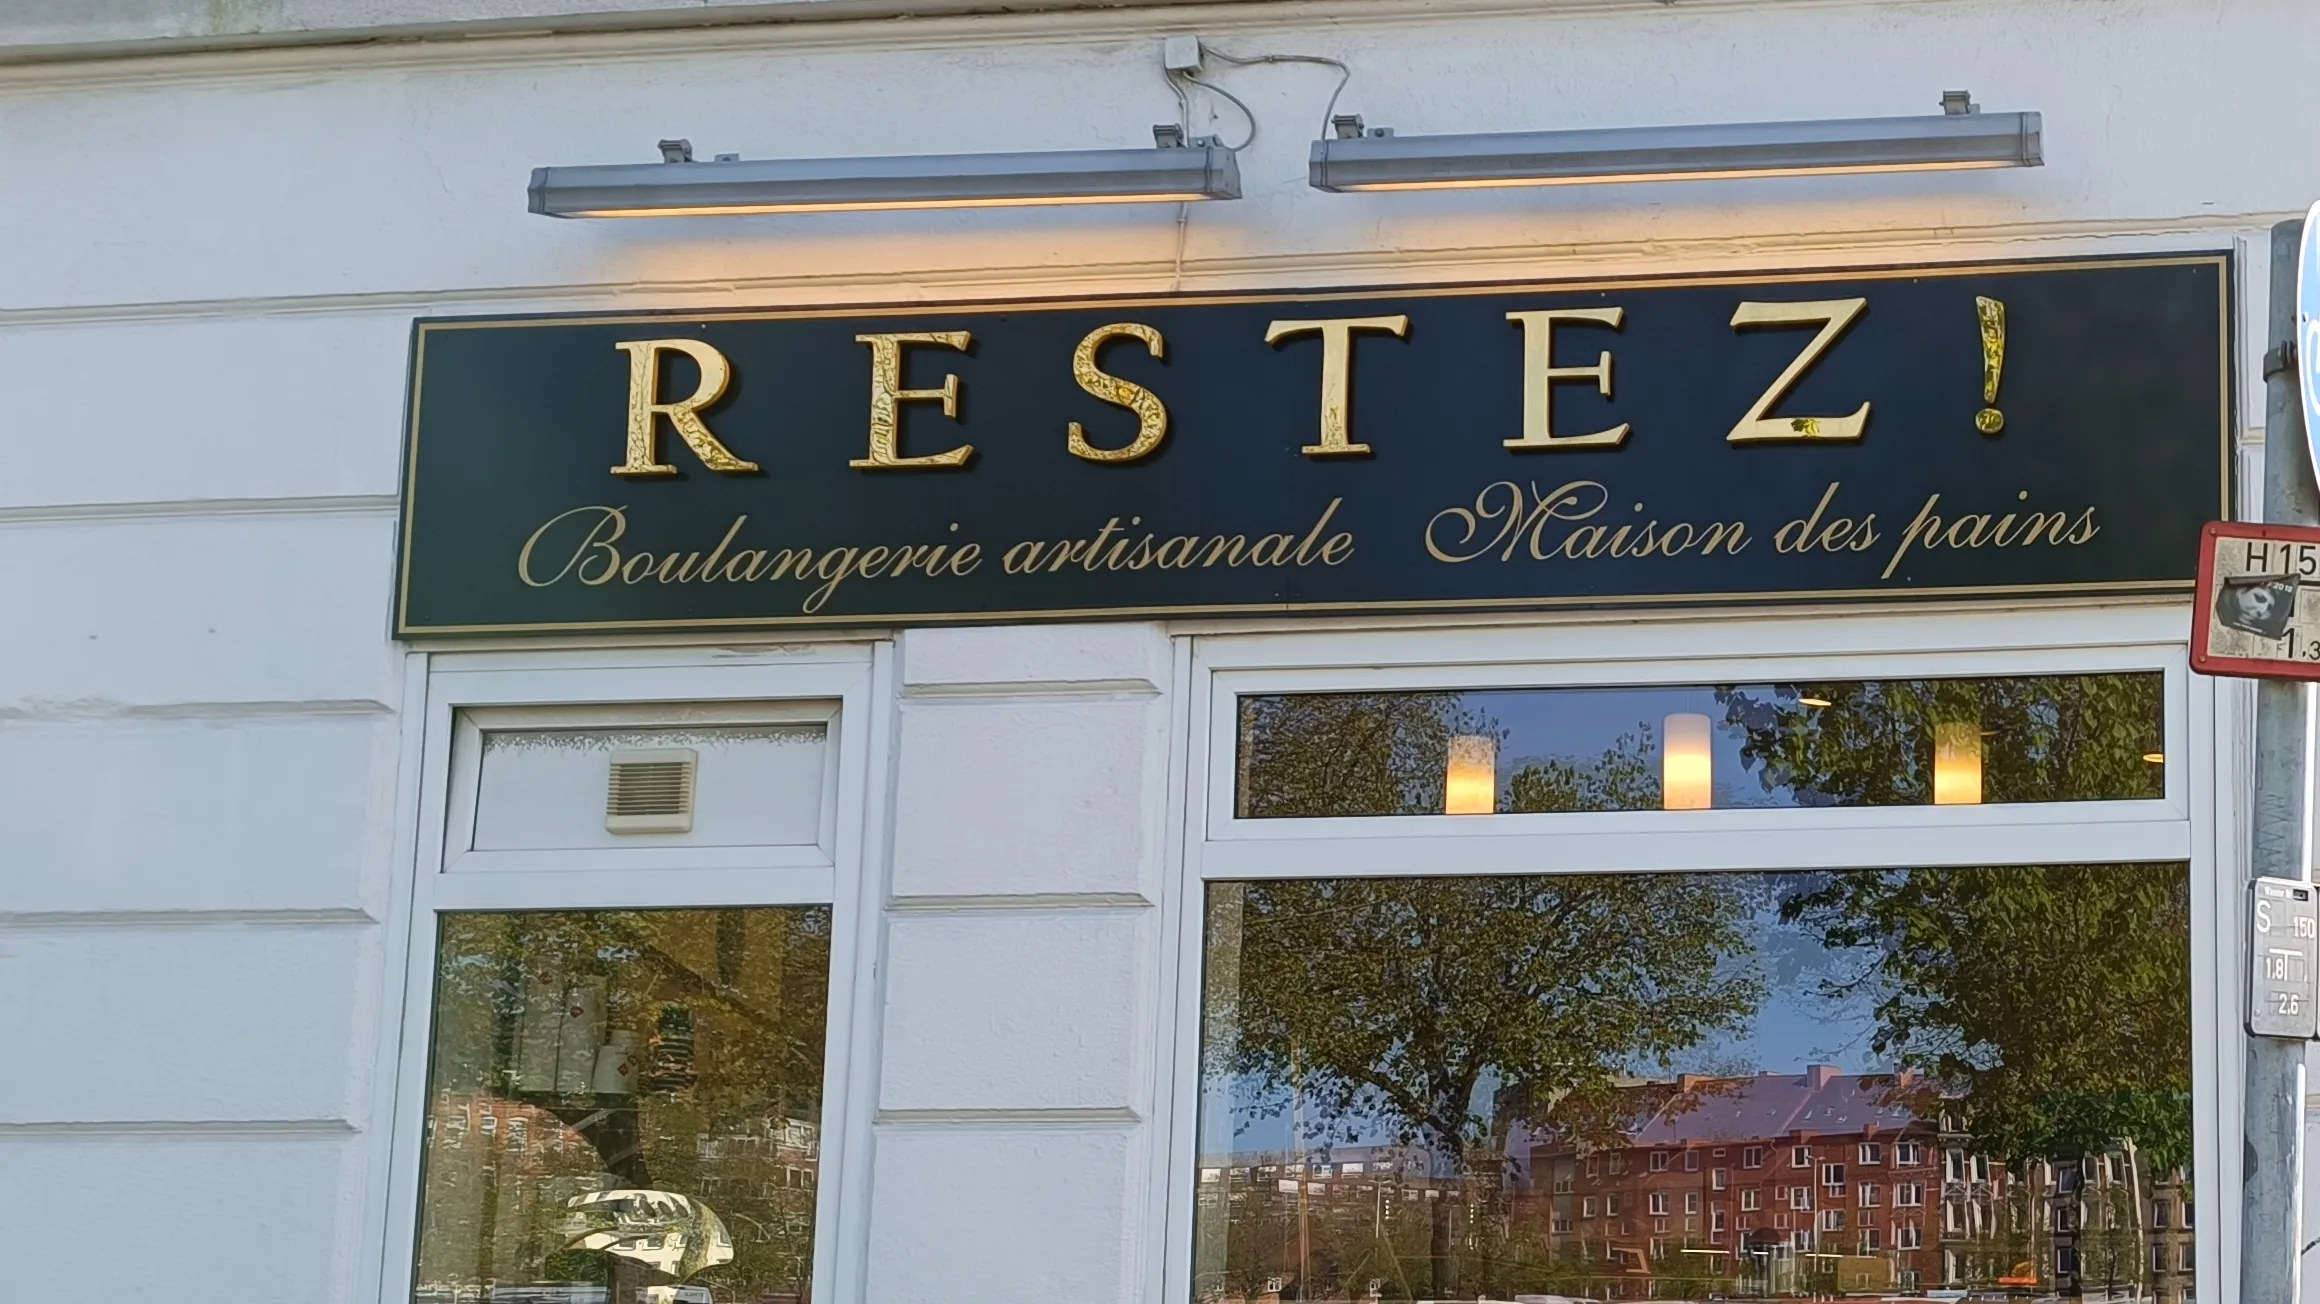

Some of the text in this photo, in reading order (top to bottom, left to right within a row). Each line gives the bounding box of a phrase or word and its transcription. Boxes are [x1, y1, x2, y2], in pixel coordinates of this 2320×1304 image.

[516, 479, 2101, 614] Boulangerie artisanale Maison des pains
[2256, 899, 2272, 934] S
[2293, 915, 2316, 939] 150
[2278, 992, 2300, 1015] 2,6
